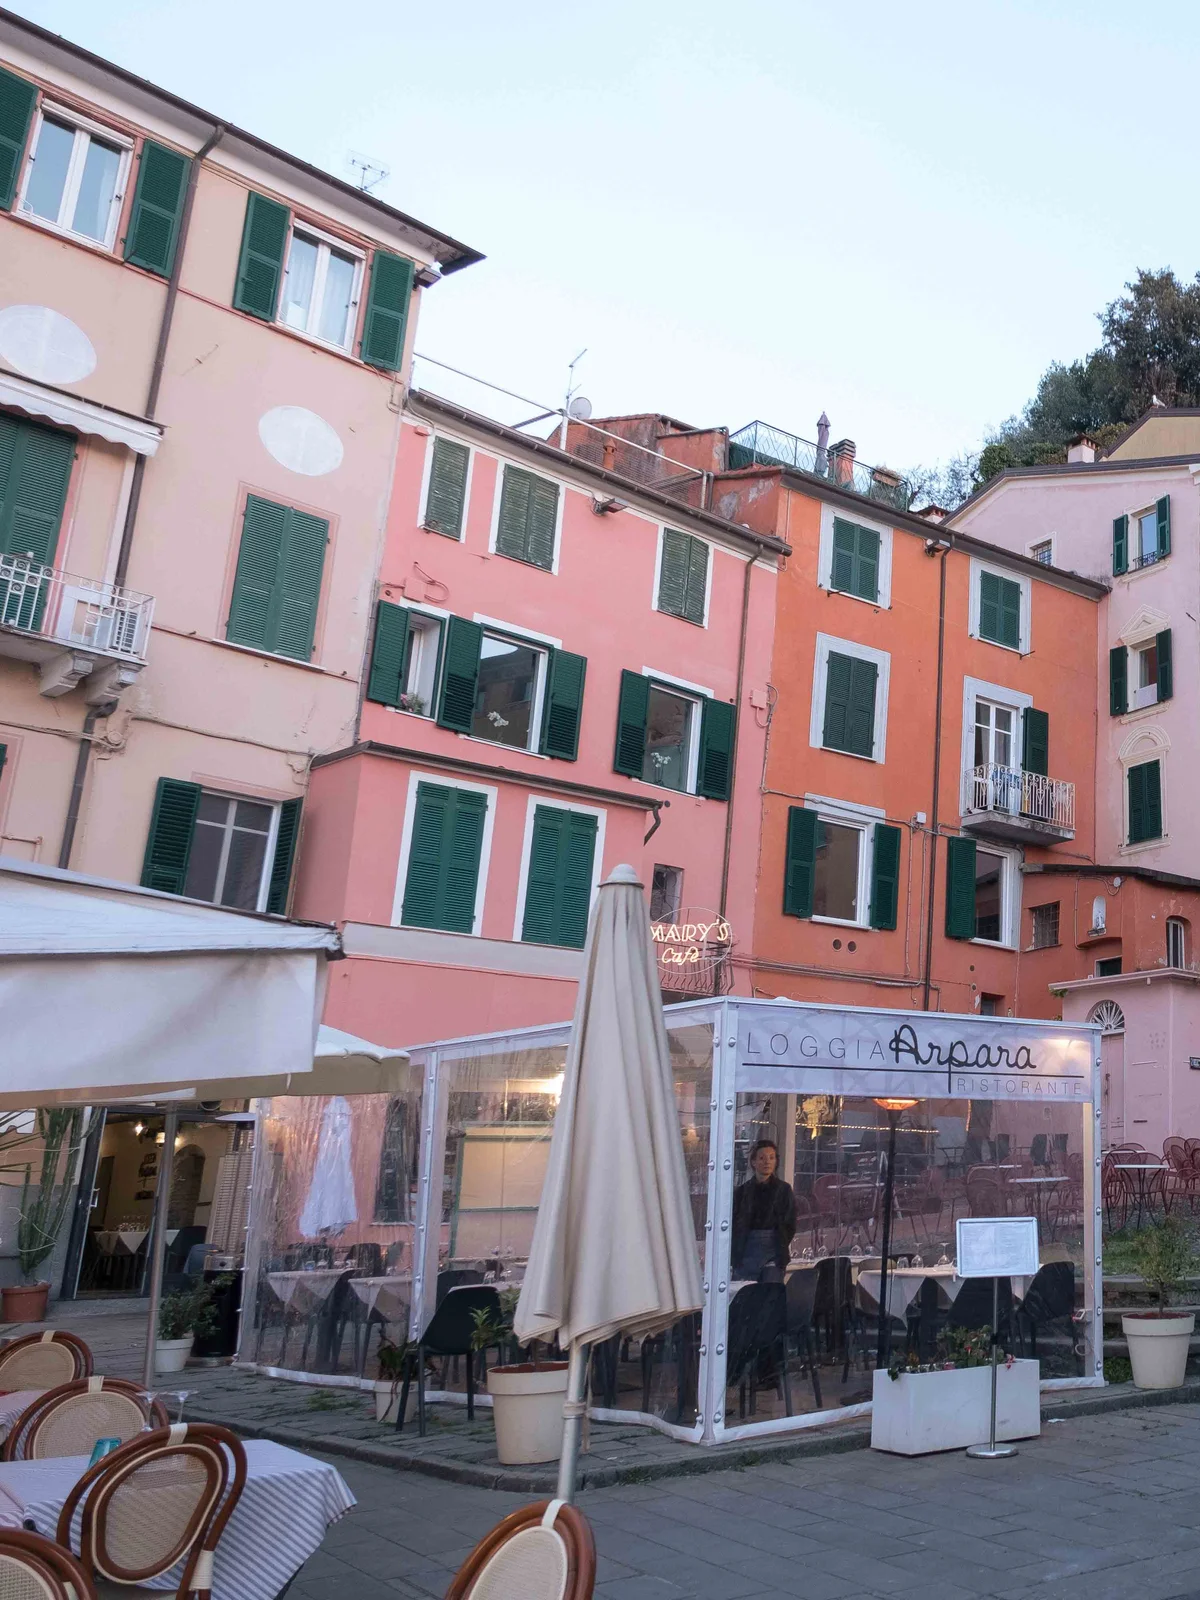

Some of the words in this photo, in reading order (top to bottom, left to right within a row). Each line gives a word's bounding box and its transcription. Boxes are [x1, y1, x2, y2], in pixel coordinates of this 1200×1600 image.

[747, 1032, 885, 1062] LOGGIA
[888, 1024, 1037, 1094] Arpara
[957, 1077, 1083, 1096] RISTORANTE
